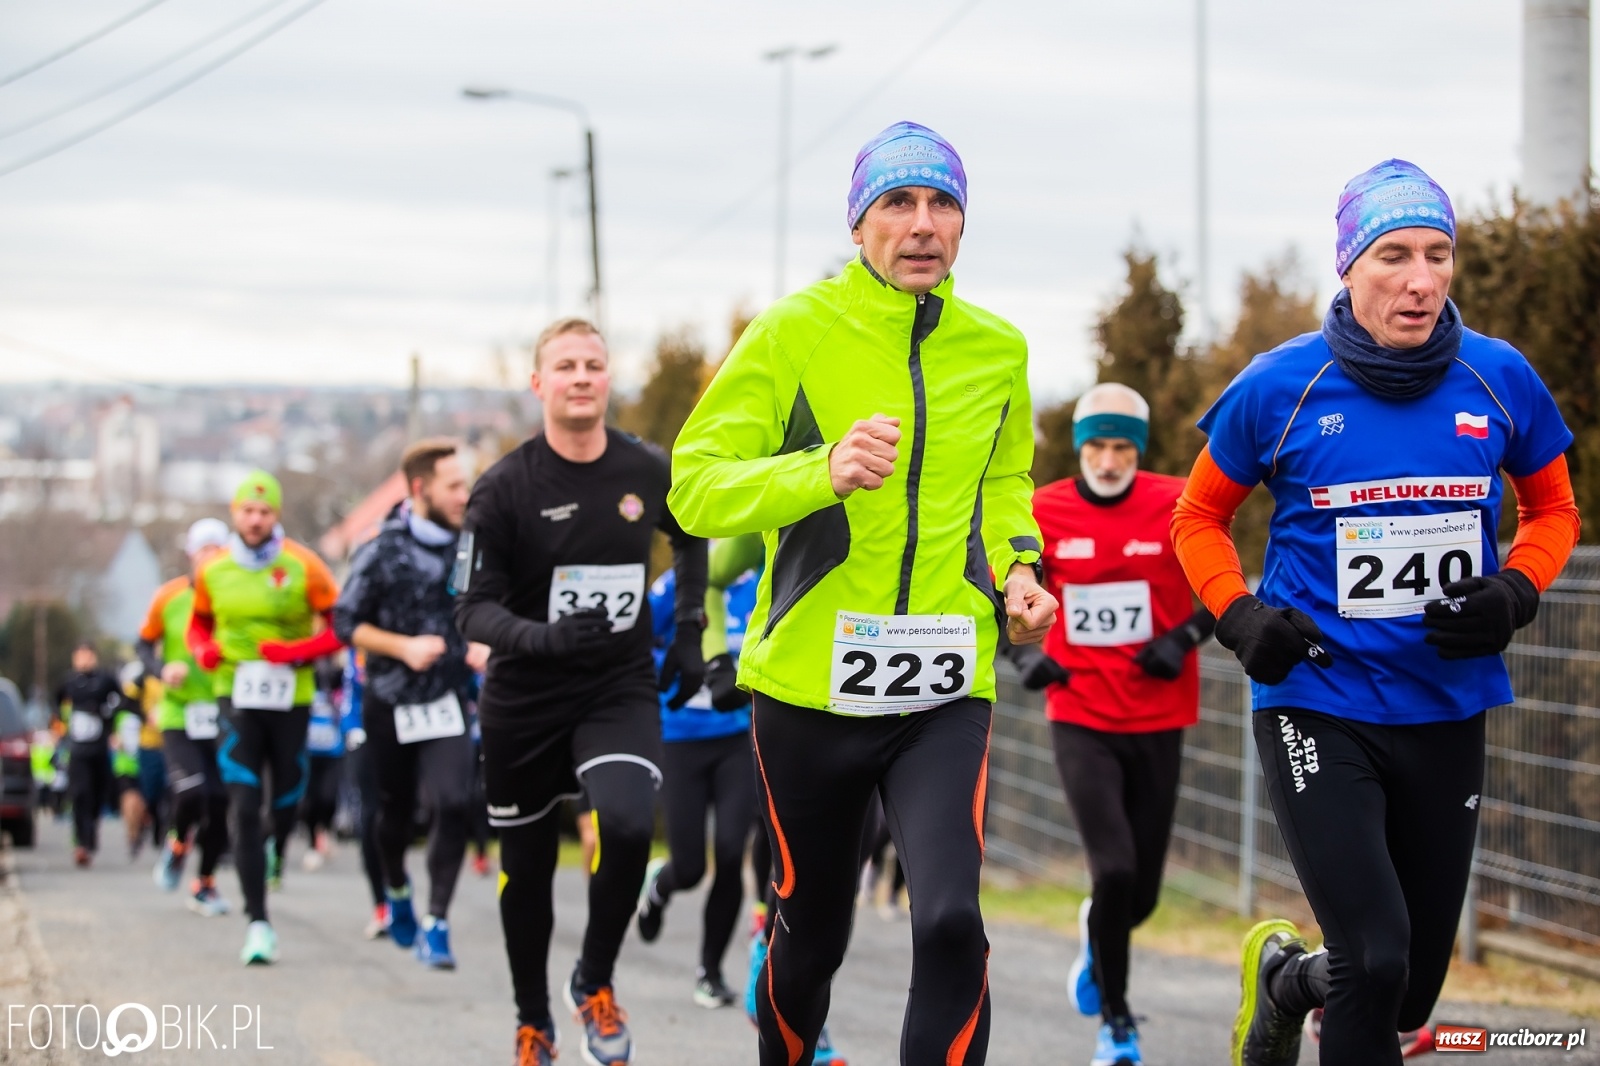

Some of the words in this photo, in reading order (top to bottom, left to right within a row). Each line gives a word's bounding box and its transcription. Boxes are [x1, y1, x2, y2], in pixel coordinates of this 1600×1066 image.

[1350, 483, 1486, 504] HELUKABEL
[1390, 522, 1476, 537] www.personalbest.pl
[1347, 549, 1473, 599] 240
[886, 626, 970, 637] www.personalbest.pl
[1073, 606, 1143, 634] 297
[839, 650, 965, 697] 223
